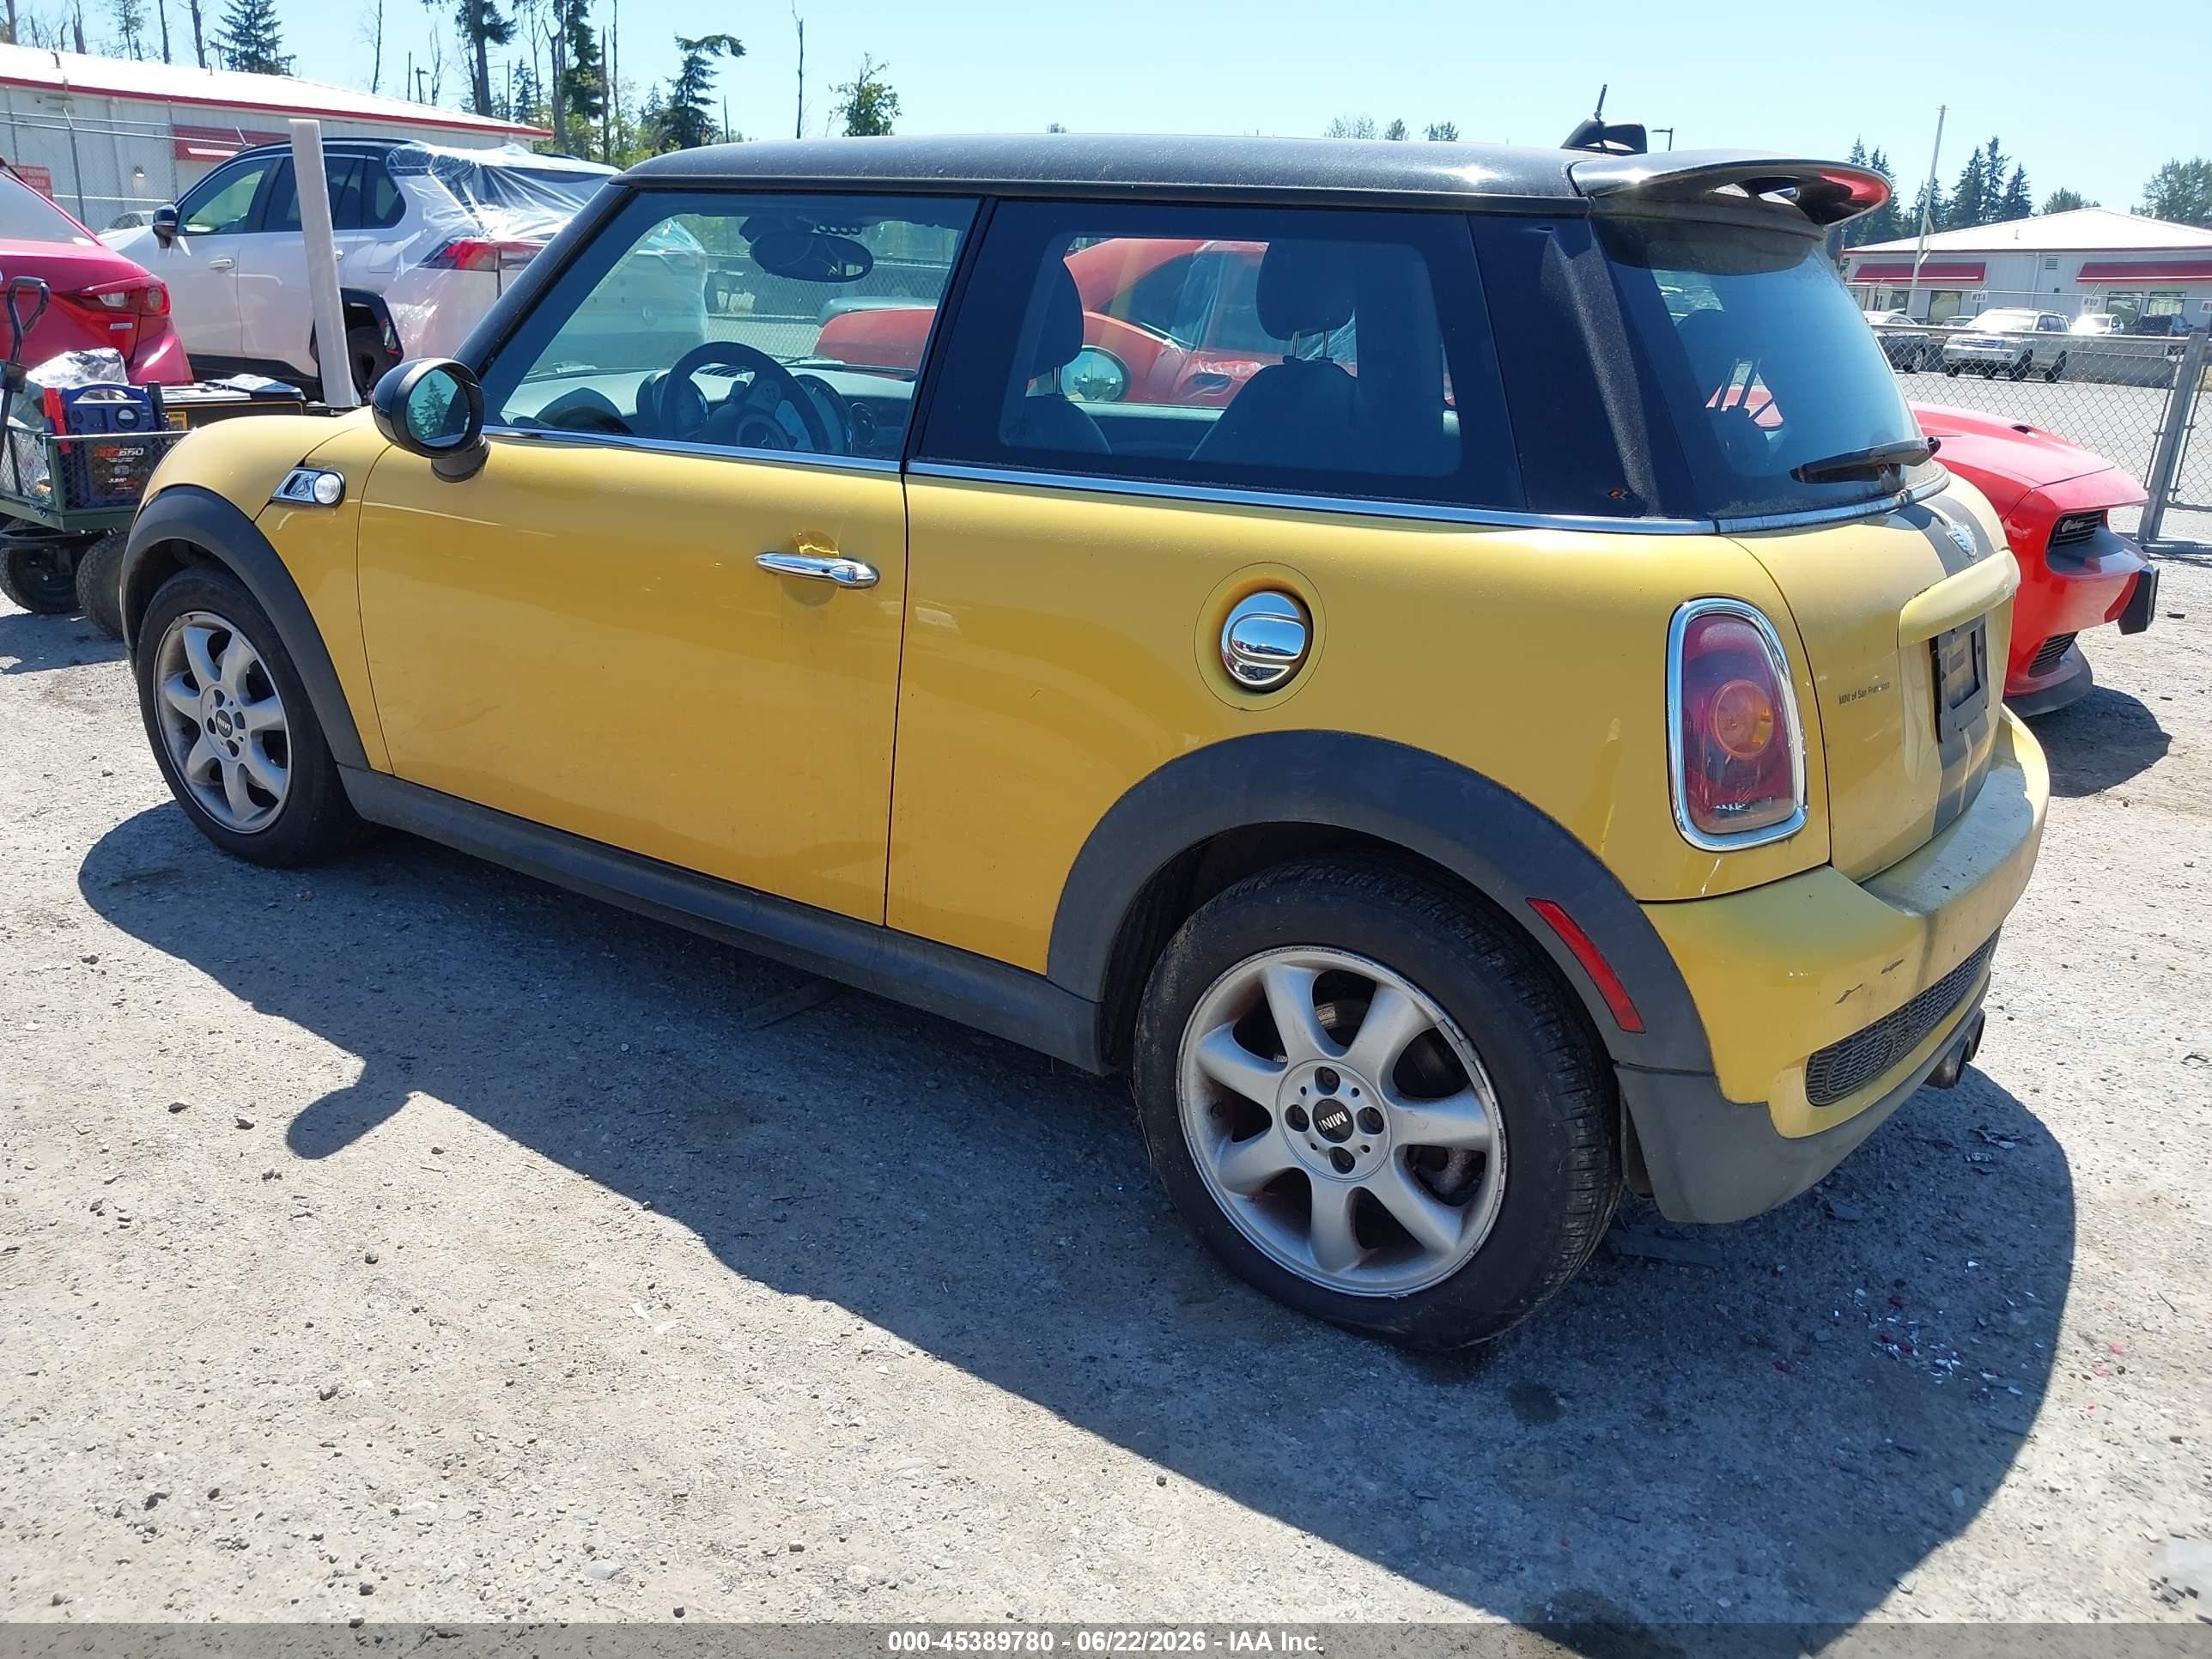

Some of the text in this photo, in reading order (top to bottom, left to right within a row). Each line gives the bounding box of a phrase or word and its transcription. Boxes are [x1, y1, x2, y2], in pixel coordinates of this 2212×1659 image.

[1838, 694, 1850, 704] MINI
[1851, 690, 1856, 701] of
[1857, 688, 1867, 698] San
[1317, 1110, 1348, 1132] MINI
